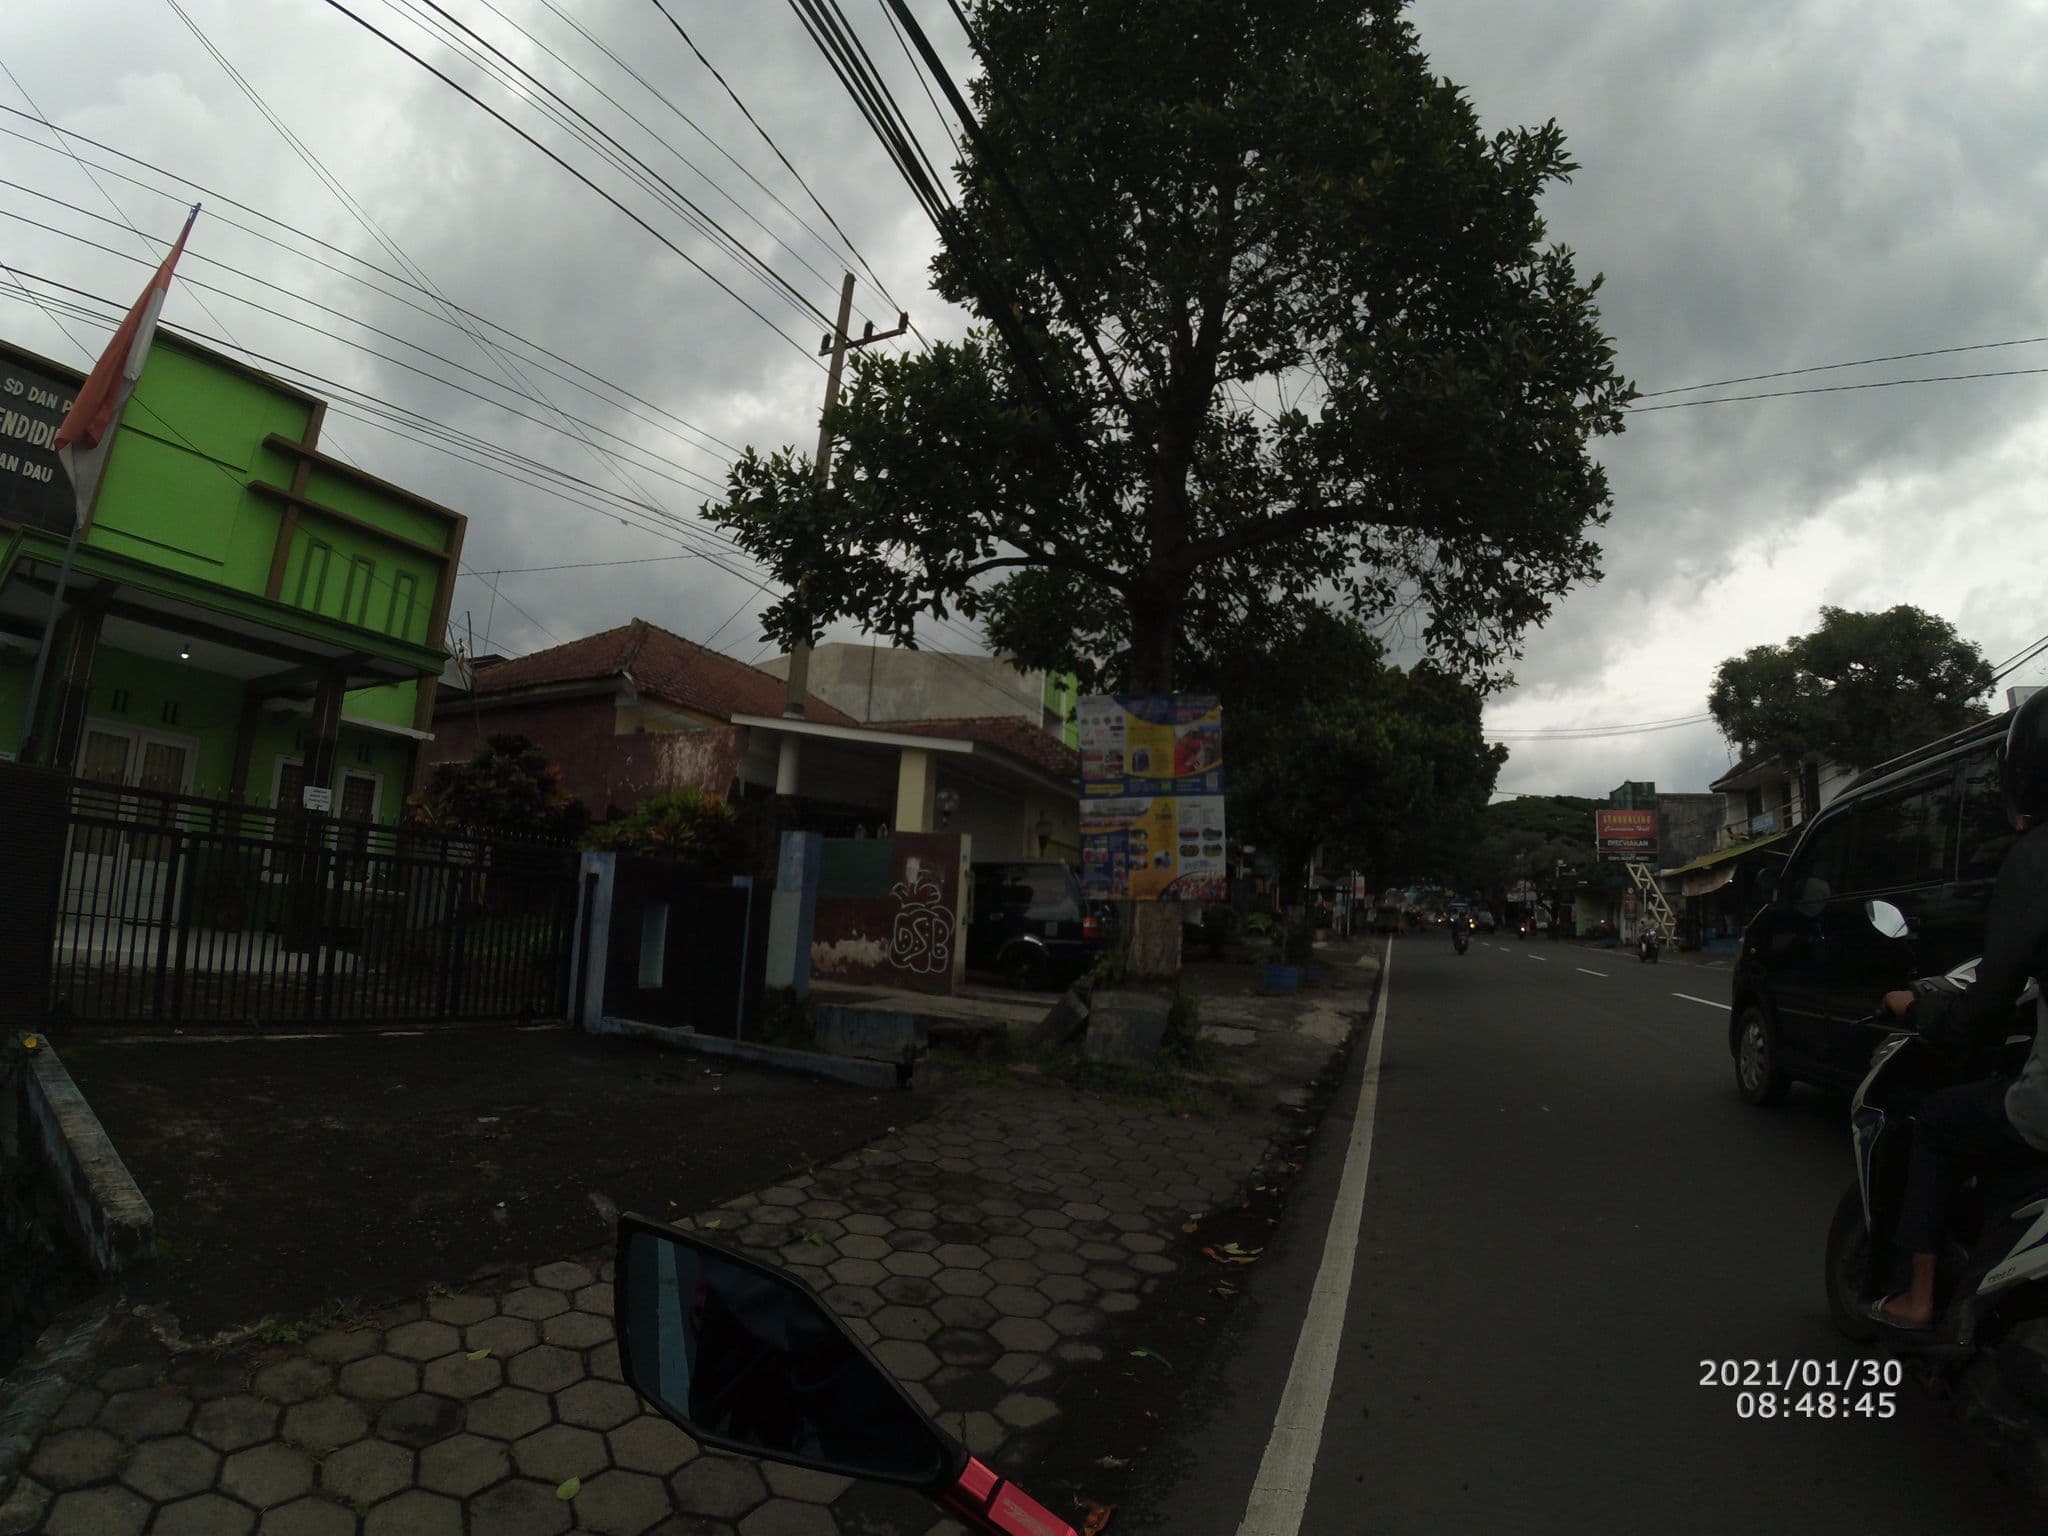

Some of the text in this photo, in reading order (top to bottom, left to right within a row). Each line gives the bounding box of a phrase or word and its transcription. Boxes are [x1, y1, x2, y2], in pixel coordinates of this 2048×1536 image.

[3, 377, 24, 396] SD
[27, 385, 58, 409] DAN
[22, 460, 54, 484] DAU
